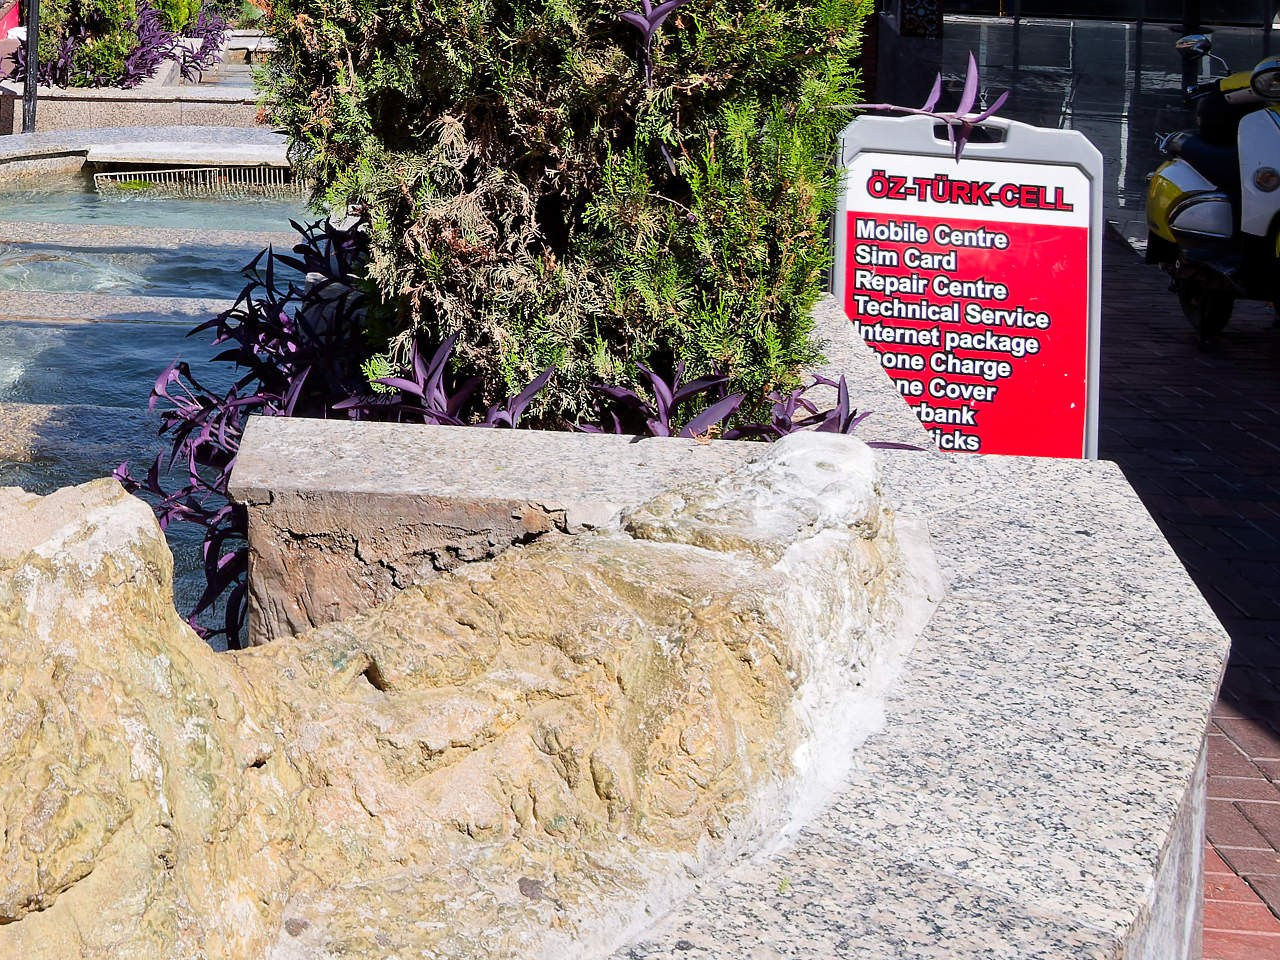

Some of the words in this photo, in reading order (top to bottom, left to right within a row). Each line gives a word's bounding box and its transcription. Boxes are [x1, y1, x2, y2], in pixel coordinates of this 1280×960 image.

[867, 168, 1074, 212] ÖZ-TÜRK-CELL
[855, 218, 929, 244] Mobile
[933, 225, 1009, 250] Centre
[854, 244, 899, 267] Sim
[904, 249, 958, 271] Card
[854, 269, 928, 294] Repair
[932, 275, 1009, 300] Centre
[853, 294, 961, 323] Technical
[964, 303, 1051, 330] Service
[944, 330, 1040, 358] package
[930, 351, 1012, 380] Charge
[929, 377, 997, 404] Cover
